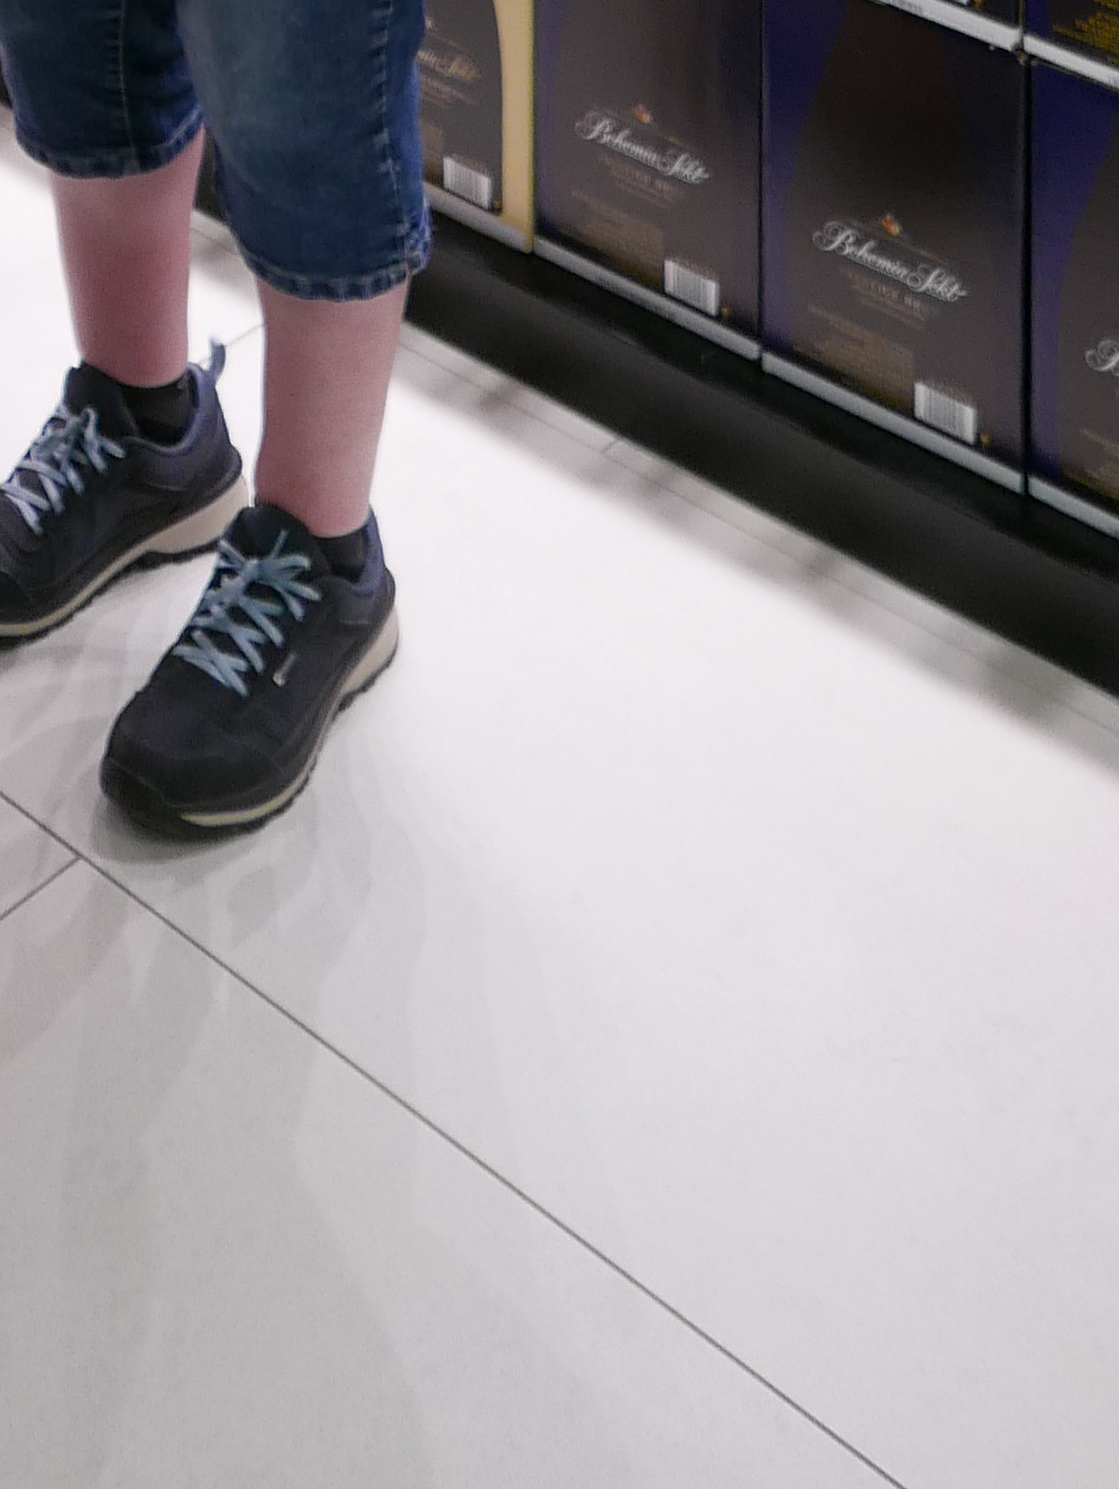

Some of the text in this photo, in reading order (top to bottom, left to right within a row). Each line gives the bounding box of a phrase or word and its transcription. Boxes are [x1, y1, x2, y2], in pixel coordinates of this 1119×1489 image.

[574, 110, 660, 169] Bohemia
[812, 220, 910, 285] Bohemia
[906, 264, 968, 303] Sekt
